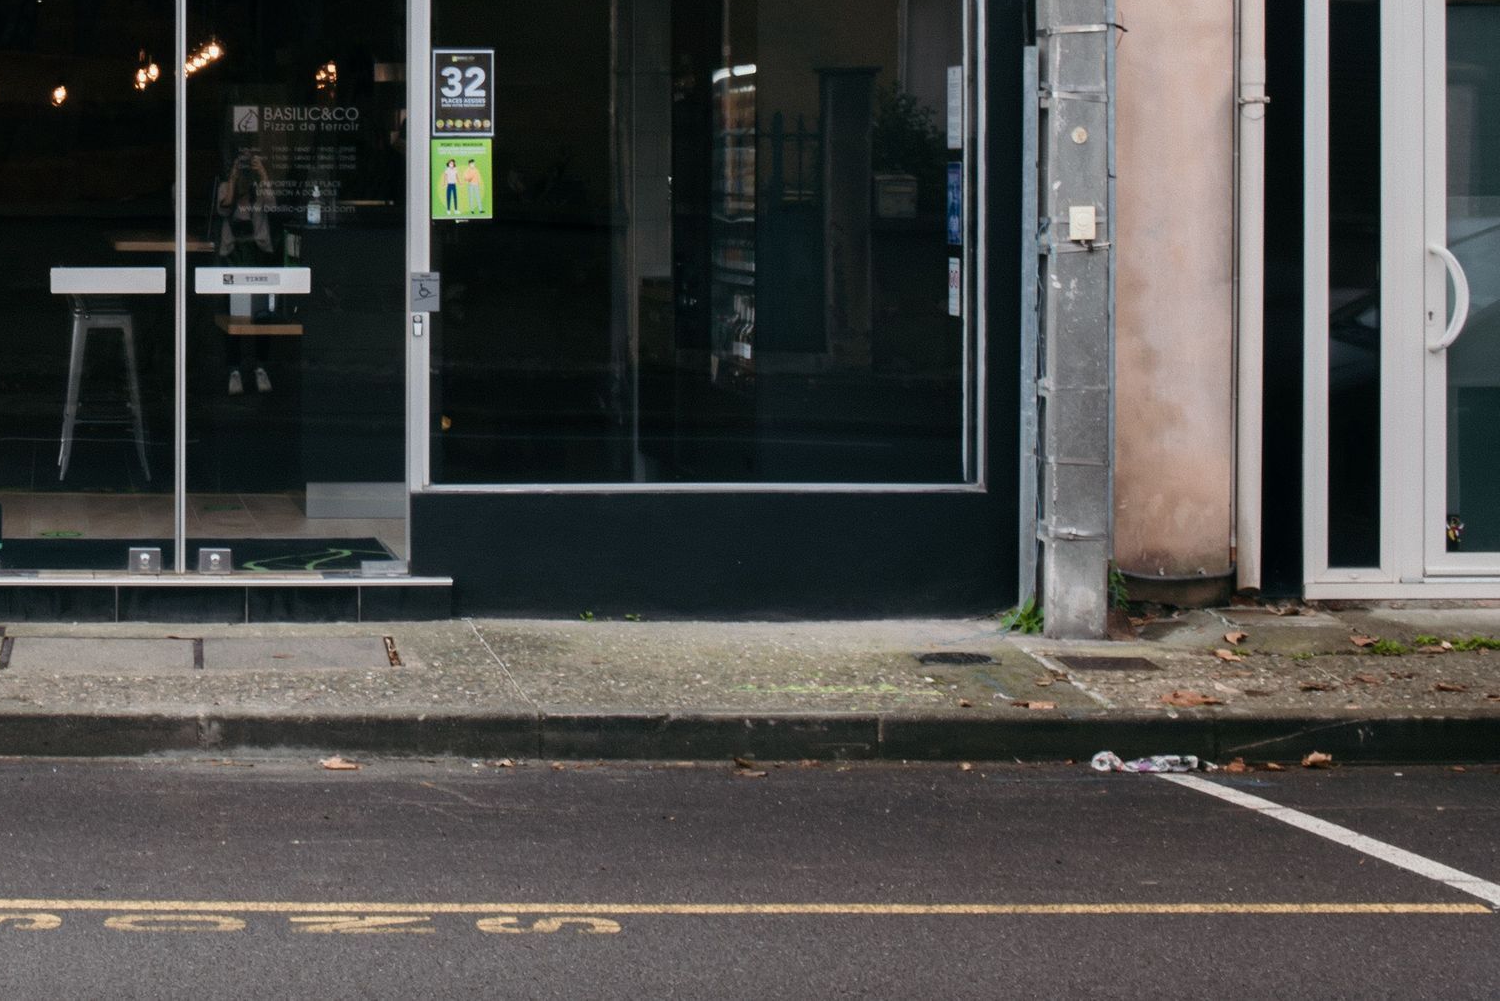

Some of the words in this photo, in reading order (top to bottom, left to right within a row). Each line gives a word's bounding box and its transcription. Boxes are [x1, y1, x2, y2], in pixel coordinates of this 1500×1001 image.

[440, 66, 486, 98] 32
[263, 106, 359, 121] BASILIC&CO
[263, 121, 295, 132] Pizza
[299, 121, 316, 132] de
[320, 121, 359, 132] terroir
